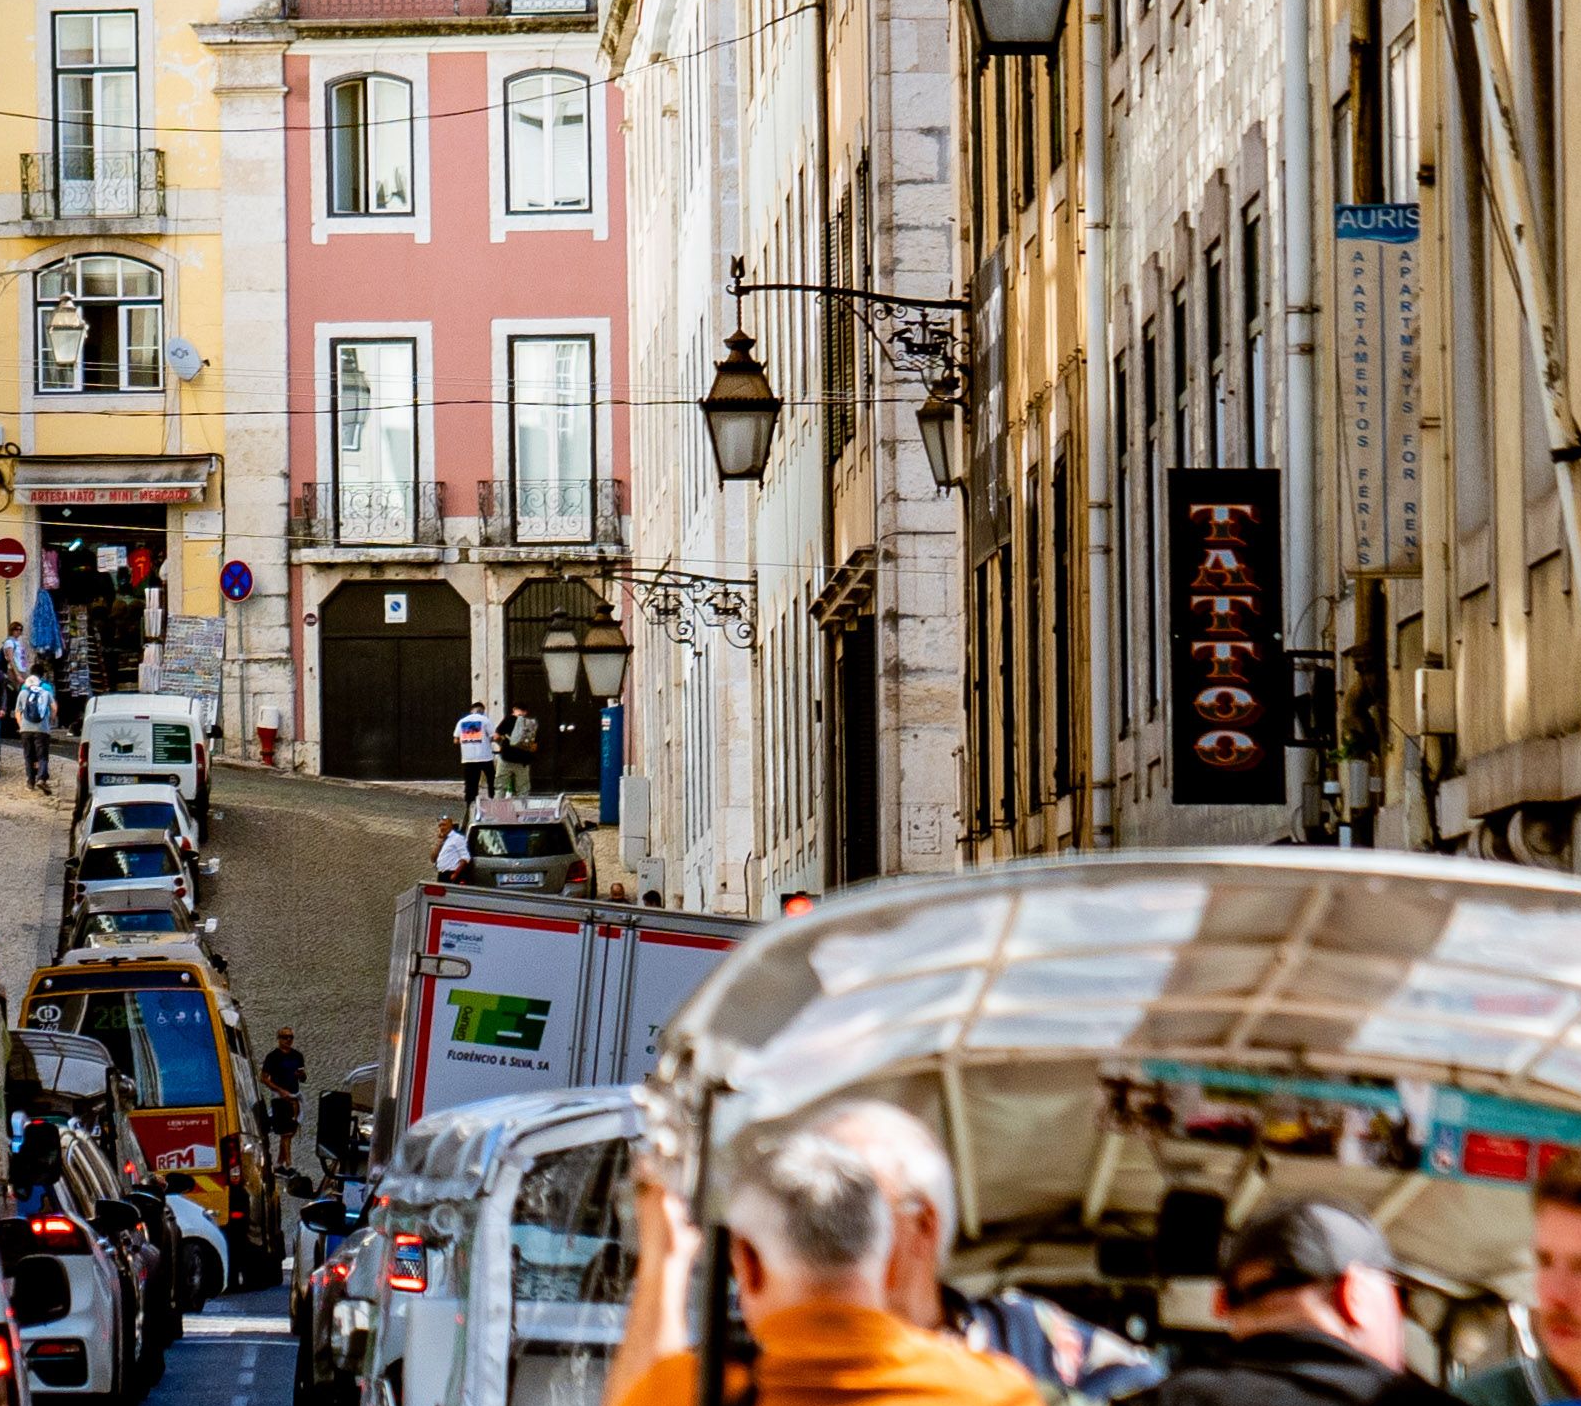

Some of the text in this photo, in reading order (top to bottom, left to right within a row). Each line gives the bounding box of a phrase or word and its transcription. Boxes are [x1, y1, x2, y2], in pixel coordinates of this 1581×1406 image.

[1337, 207, 1421, 230] AURIS
[1351, 250, 1371, 448] APARTAMENTOS
[1398, 250, 1419, 564] APARTMENTS FOR RENT
[30, 489, 96, 503] ARTESANATO
[1189, 503, 1264, 772] TATTOO
[455, 1005, 474, 1041] GRUPO
[446, 1049, 550, 1071] FLORÊNCIO & SILVA, SA
[157, 1148, 195, 1171] RFM
